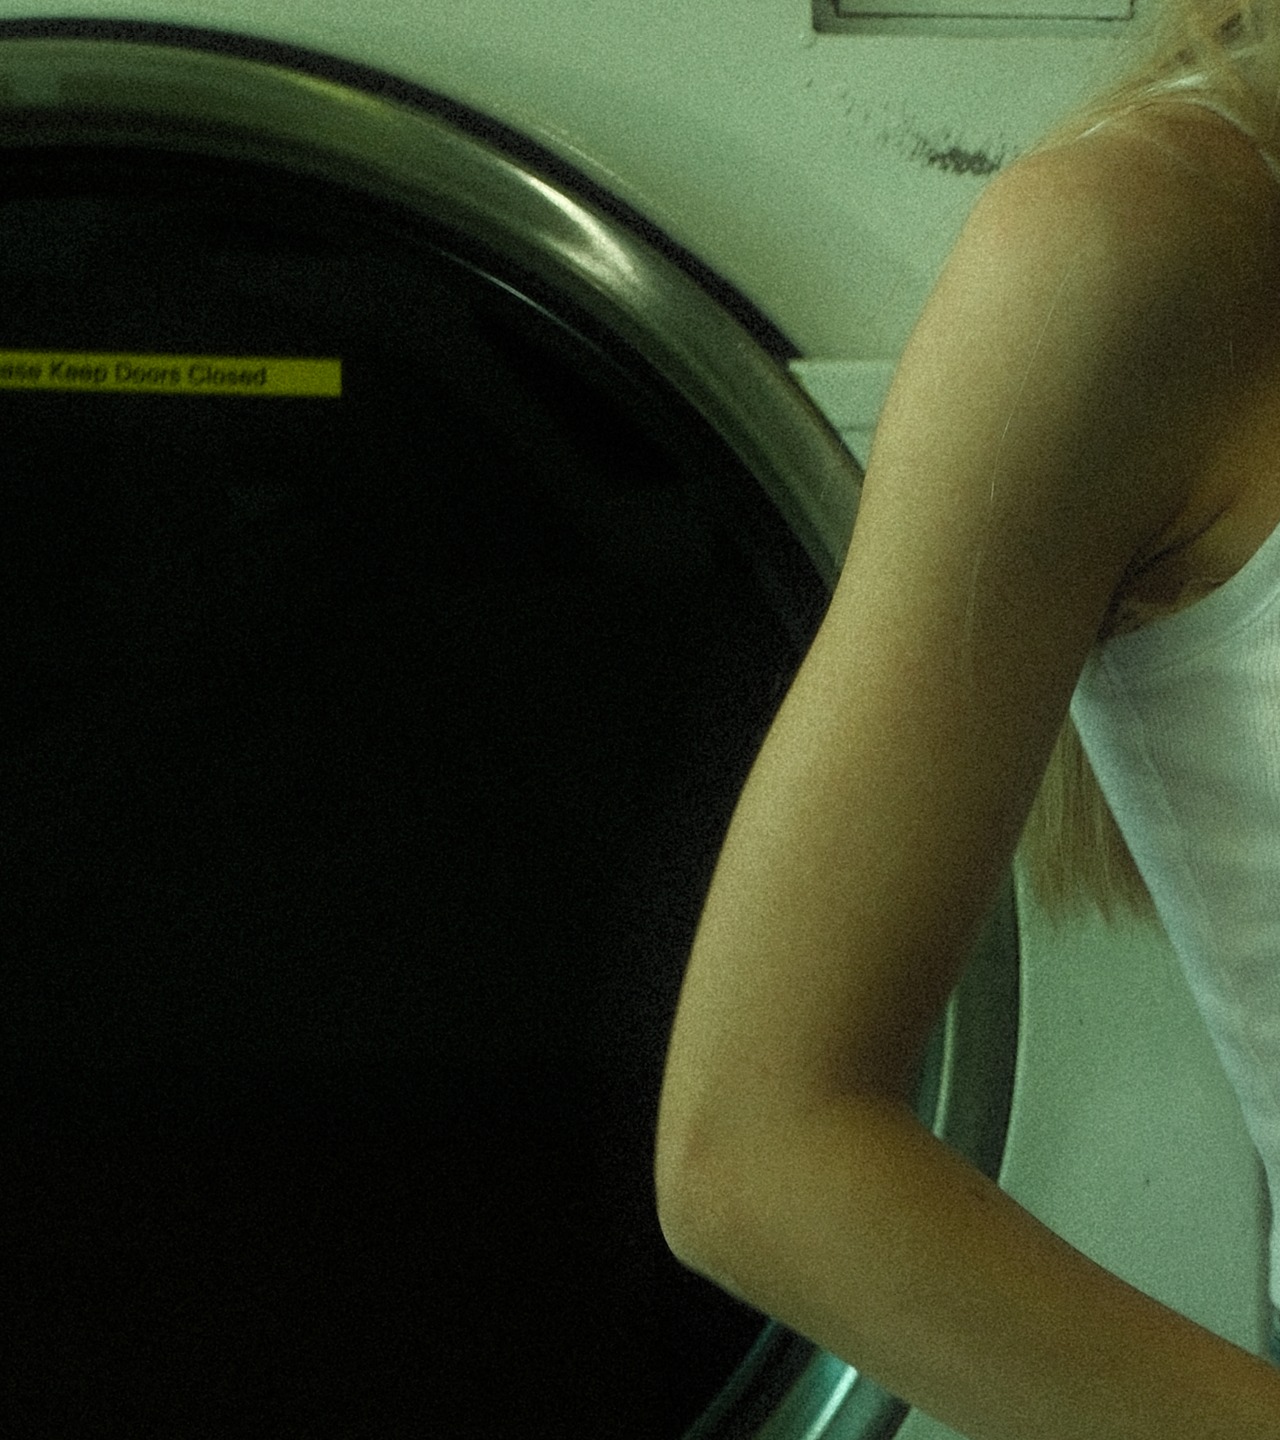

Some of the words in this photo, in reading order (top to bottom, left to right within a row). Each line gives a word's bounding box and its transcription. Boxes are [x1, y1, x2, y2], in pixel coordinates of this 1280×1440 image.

[49, 361, 108, 384] Keep
[114, 361, 182, 385] Doors
[188, 364, 267, 387] Closed
